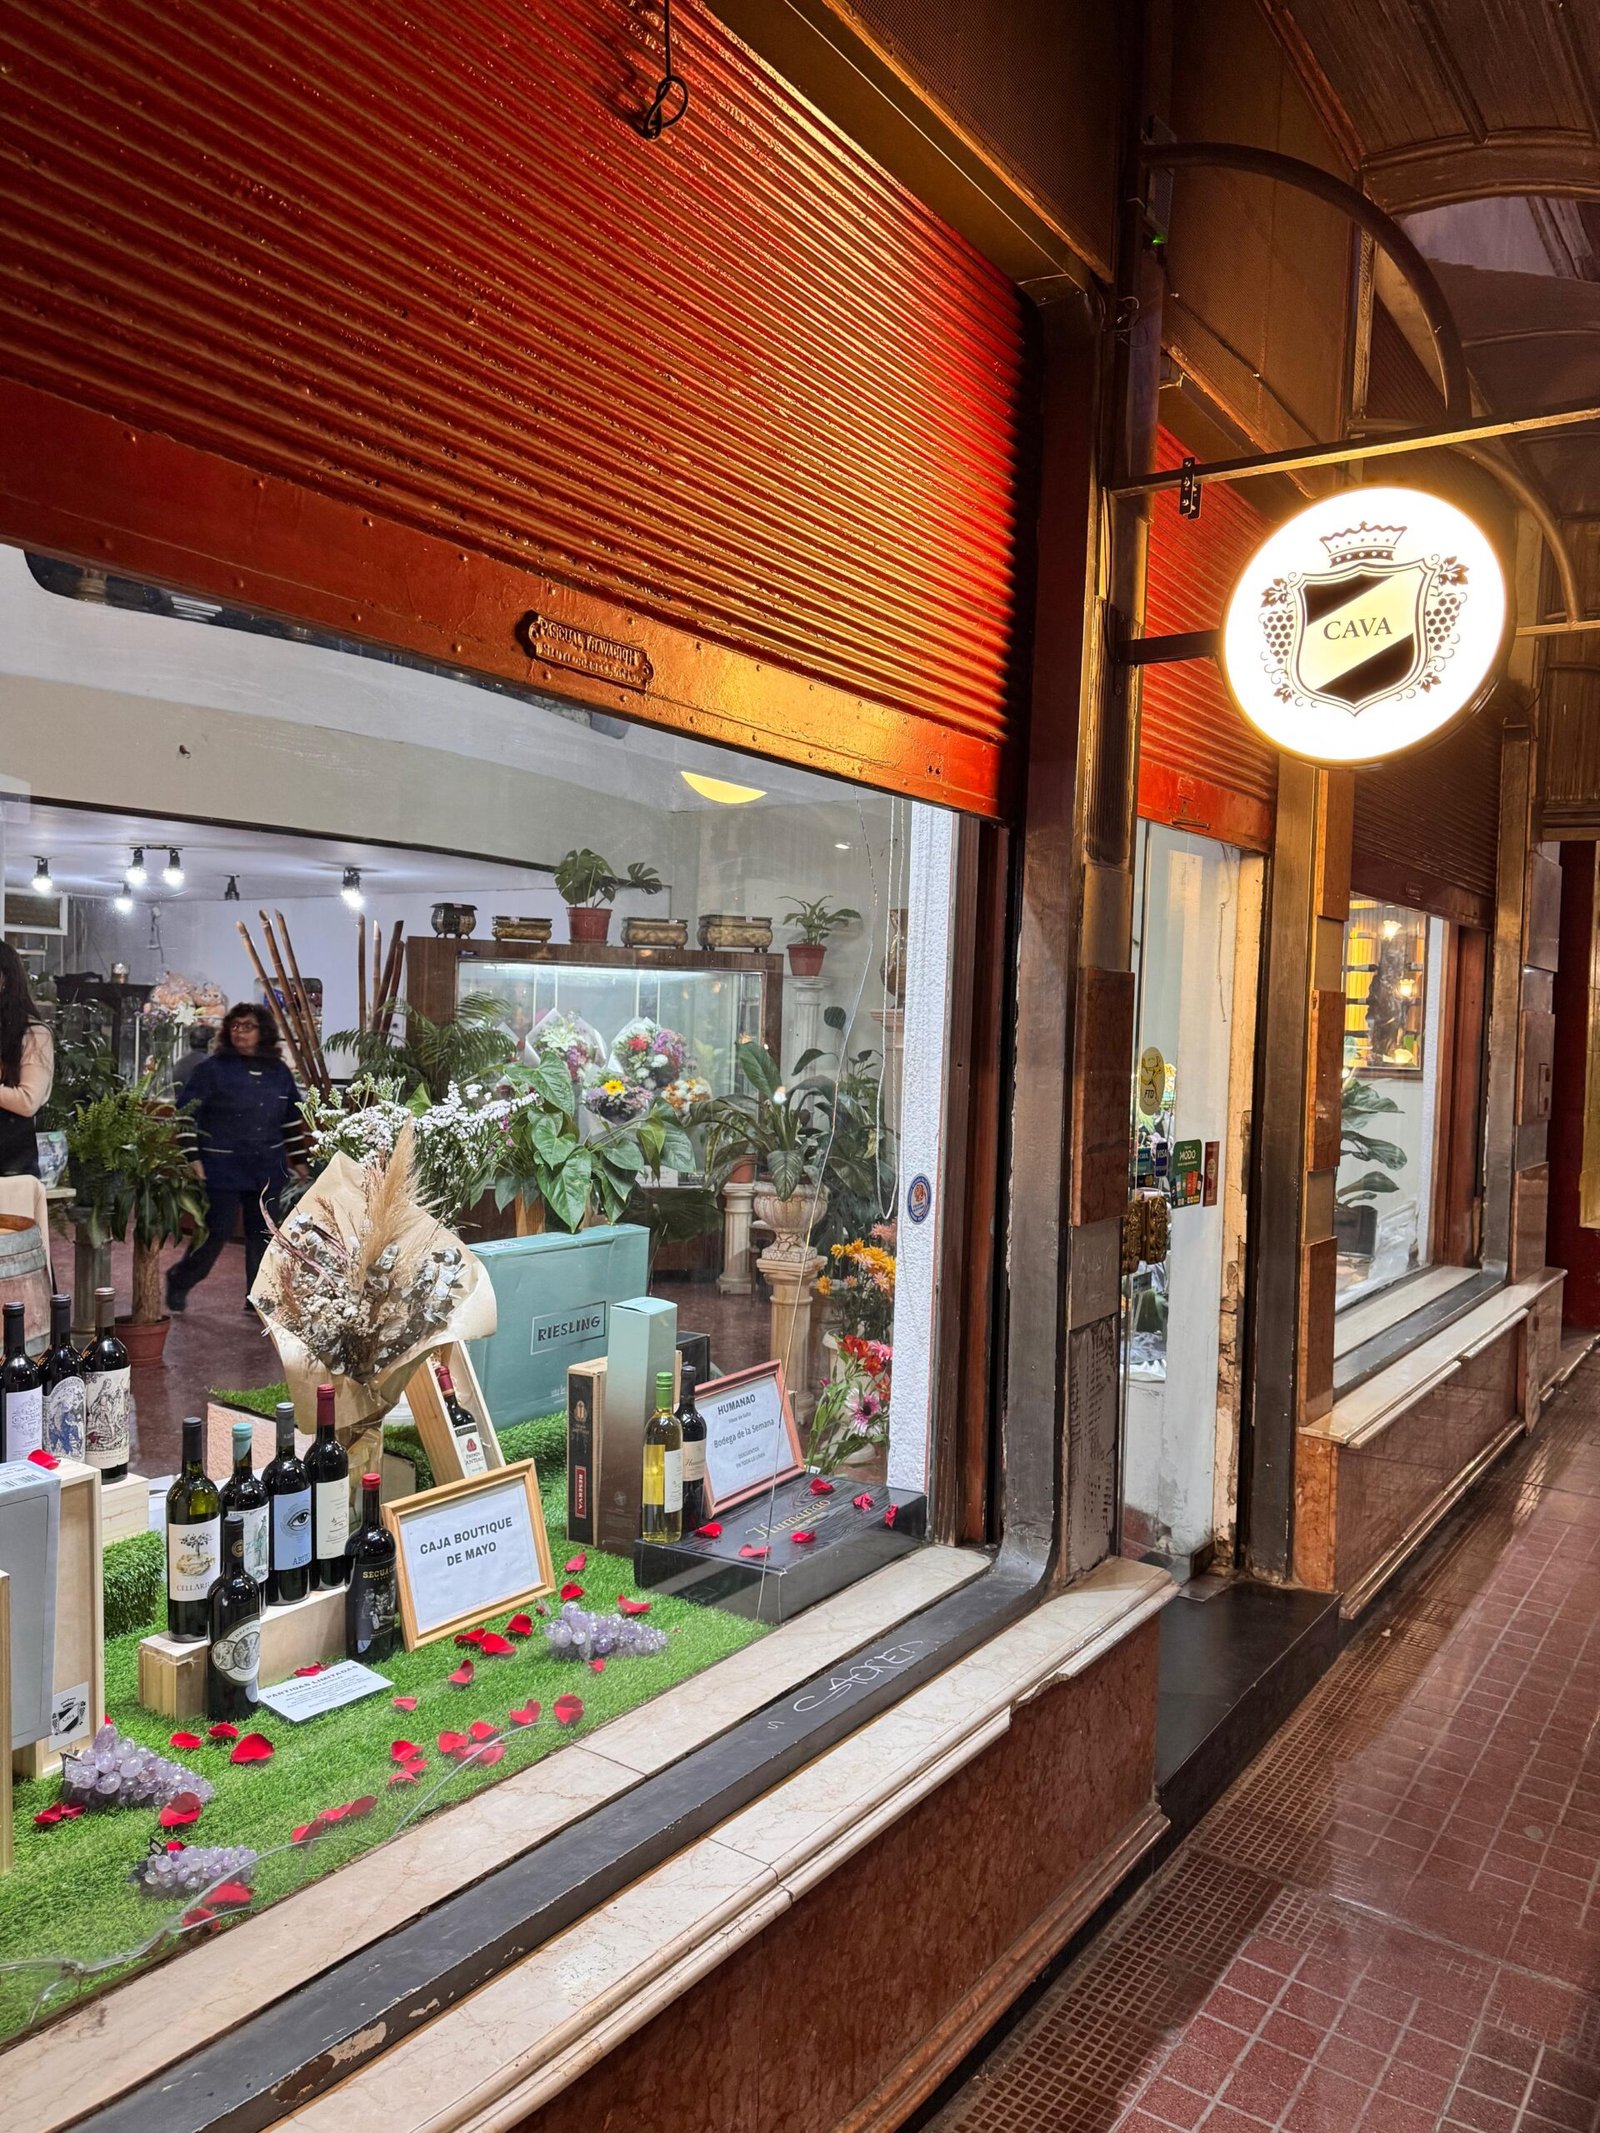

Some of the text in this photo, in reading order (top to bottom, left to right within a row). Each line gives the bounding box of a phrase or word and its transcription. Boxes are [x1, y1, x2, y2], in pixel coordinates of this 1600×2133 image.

[1323, 616, 1393, 641] CAVA
[1144, 1089, 1155, 1099] FTD
[1179, 1149, 1197, 1161] MODO
[537, 1316, 600, 1341] RIESLING
[717, 1394, 756, 1415] HUMANAO
[713, 1418, 775, 1449] Bodega de la Semana
[745, 1499, 831, 1540] Humanao
[420, 1517, 513, 1555] CAJA BOUTIQUE
[447, 1542, 497, 1566] DE MAYO
[266, 1682, 311, 1699] PARTIDAS
[311, 1665, 359, 1685] LIMITADAS
